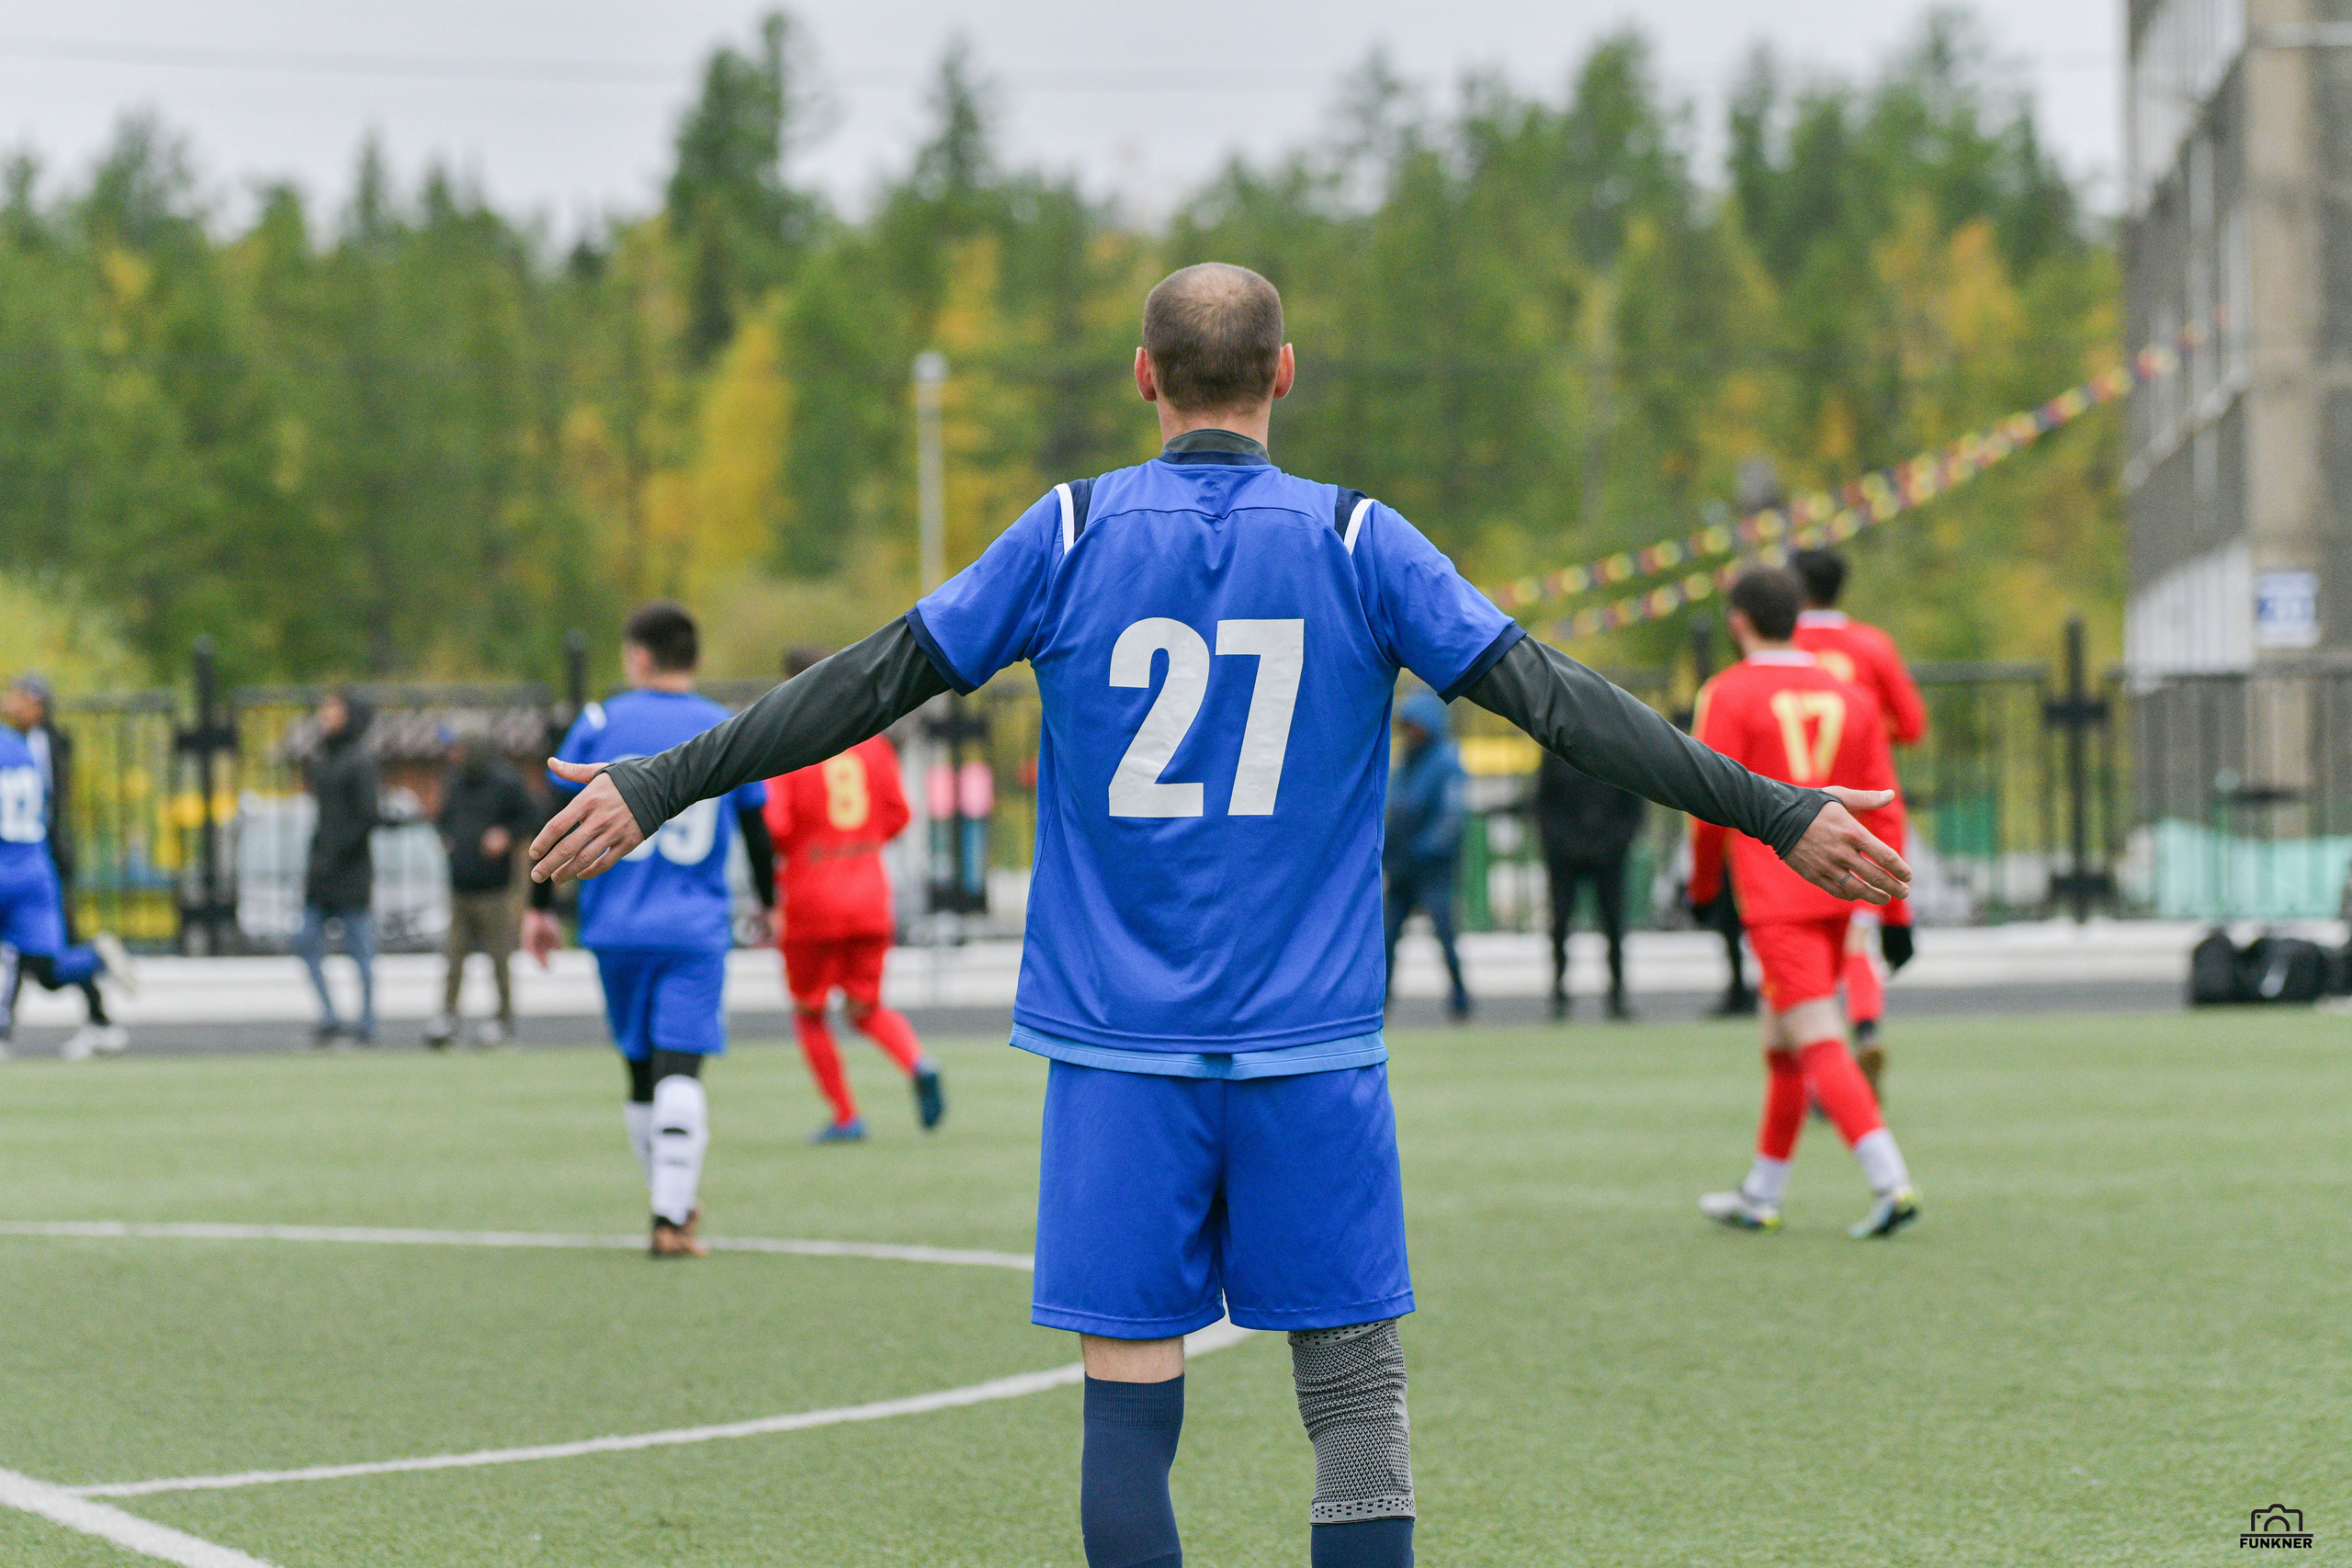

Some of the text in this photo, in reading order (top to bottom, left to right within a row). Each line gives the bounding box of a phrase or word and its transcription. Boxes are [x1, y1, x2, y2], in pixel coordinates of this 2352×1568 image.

[1108, 617, 1305, 818] 27
[1770, 689, 1847, 784] 17
[821, 749, 872, 831] 8
